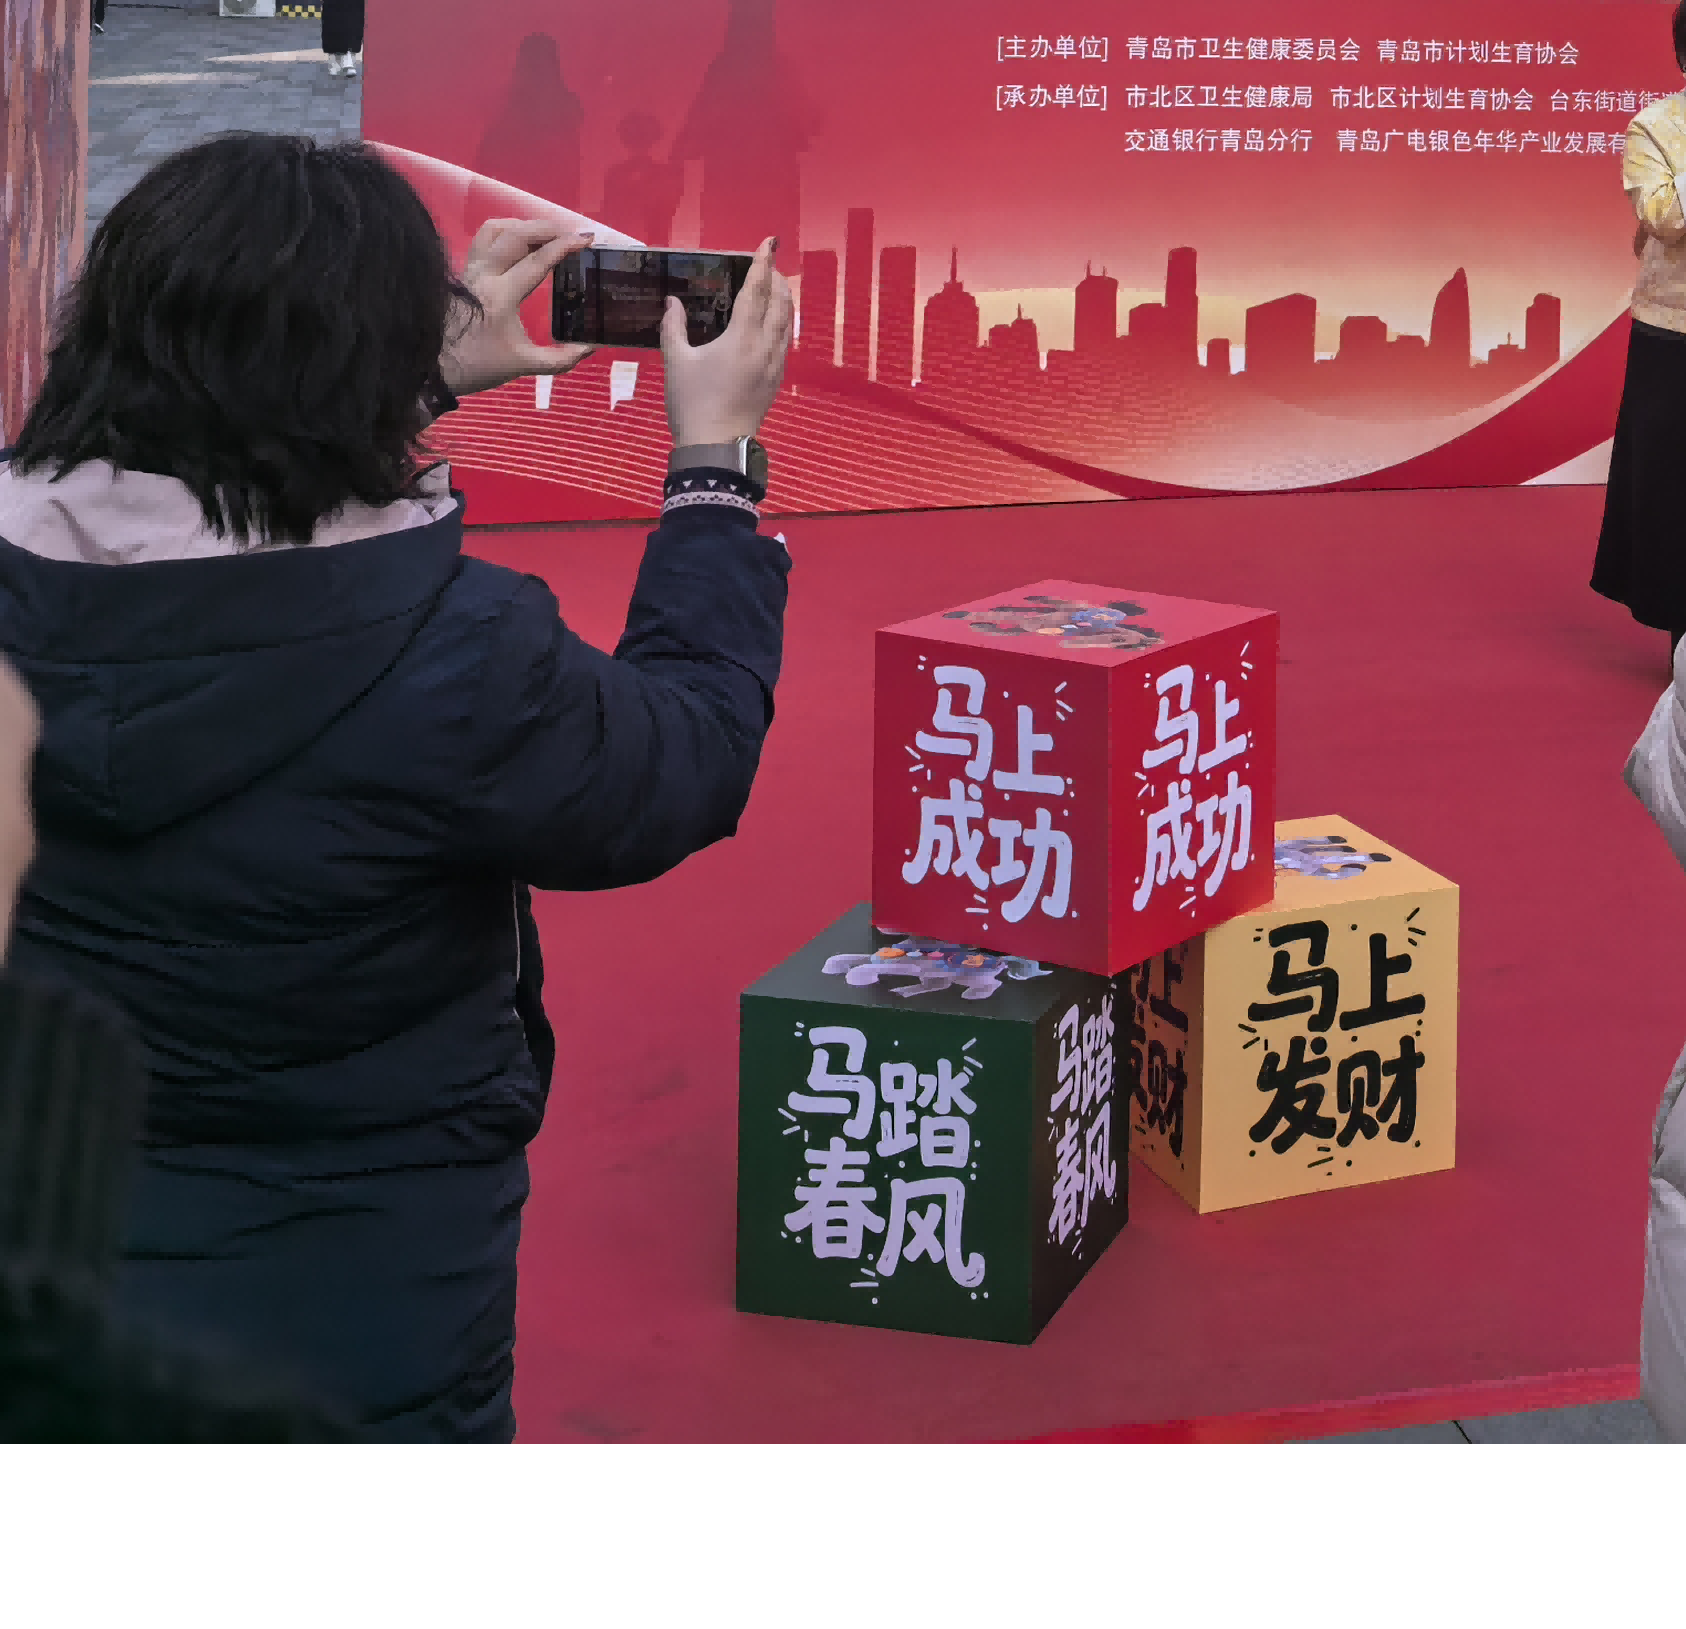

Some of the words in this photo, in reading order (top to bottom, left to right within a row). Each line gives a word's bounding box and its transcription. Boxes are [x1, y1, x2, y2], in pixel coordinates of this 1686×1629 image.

[996, 84, 1108, 111] [承办单位]
[1125, 85, 1313, 109] 市北区卫生健康局
[1330, 86, 1534, 112] 市北区计划生育协会
[997, 35, 1109, 62] [主办单位]
[1125, 36, 1360, 62] 青岛市卫生健康委员会
[1377, 39, 1580, 65] 青岛市计划生育协会
[1124, 128, 1313, 152] 交通银行青岛分行
[1337, 129, 1626, 155] 青岛广电银色年华产业发展有
[915, 664, 1066, 798] 马上
[1141, 664, 1248, 774] 马上
[902, 779, 1074, 923] 成功
[1132, 769, 1253, 913] 成功
[1247, 919, 1427, 1033] 马上
[787, 1026, 978, 1169] 马踏
[1050, 994, 1115, 1118] 马踏
[1250, 1036, 1427, 1155] 发财
[785, 1138, 986, 1288] 春风
[1047, 1101, 1117, 1245] 春风
